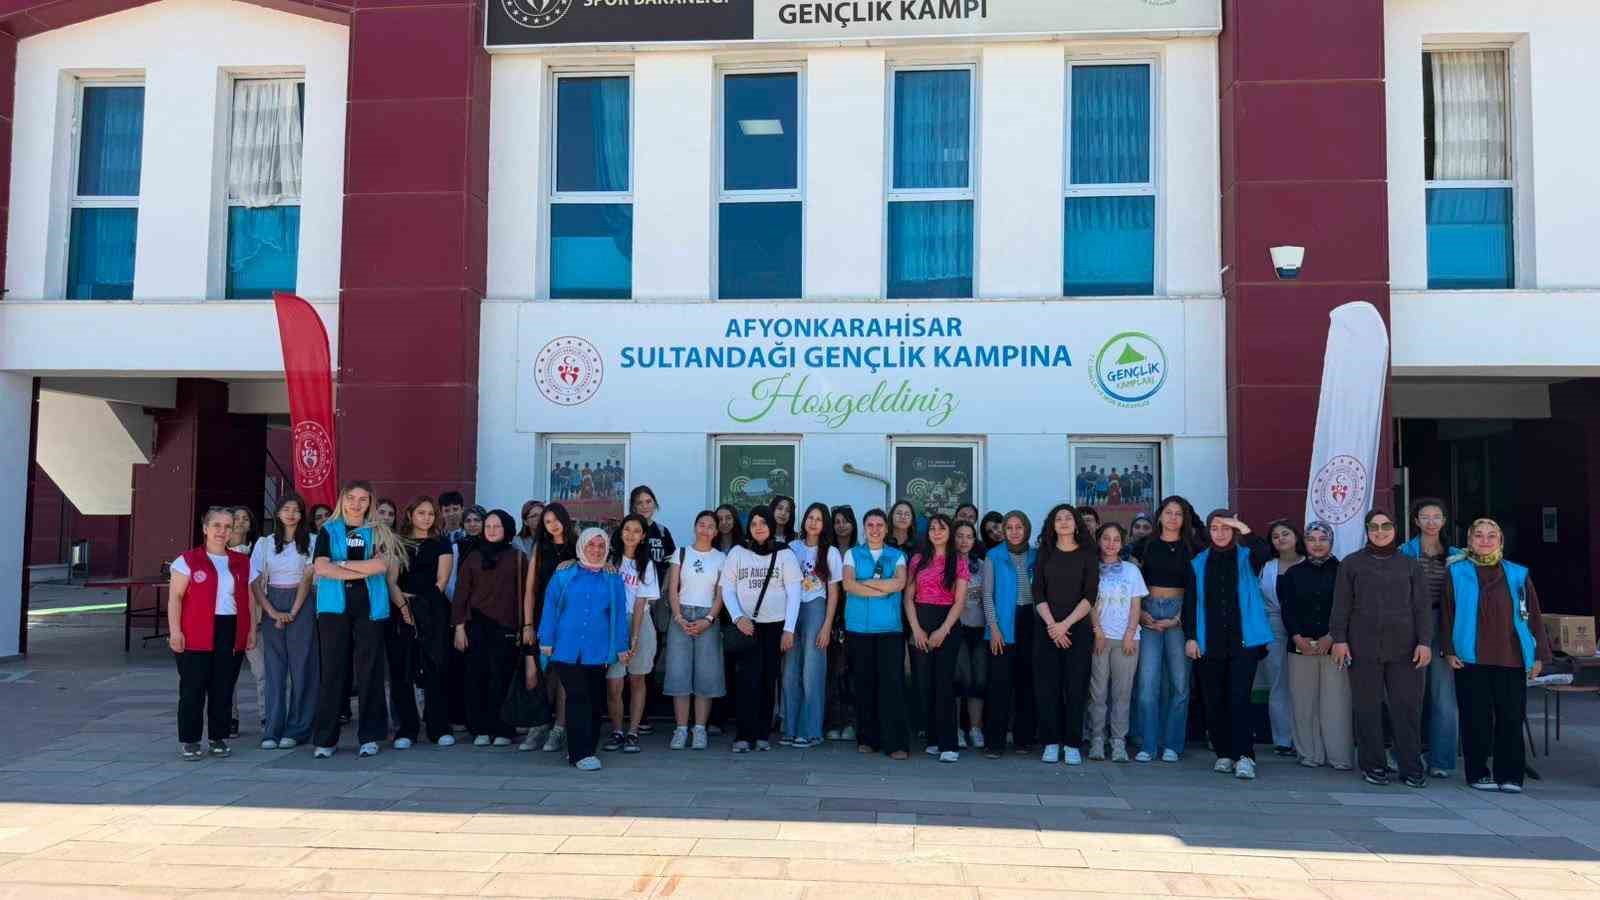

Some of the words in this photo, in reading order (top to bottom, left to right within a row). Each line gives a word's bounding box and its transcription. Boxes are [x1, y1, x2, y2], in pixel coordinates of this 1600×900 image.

[900, 0, 986, 20] KAMPI
[725, 313, 962, 338] AFYONKARAHİSAR
[620, 341, 796, 368] SULTANDAĞI
[804, 341, 926, 374] GENÇLİK
[934, 345, 1072, 368] KAMPINA
[1107, 361, 1160, 382] GENÇLİK
[727, 372, 960, 429] Hoşgeldiniz
